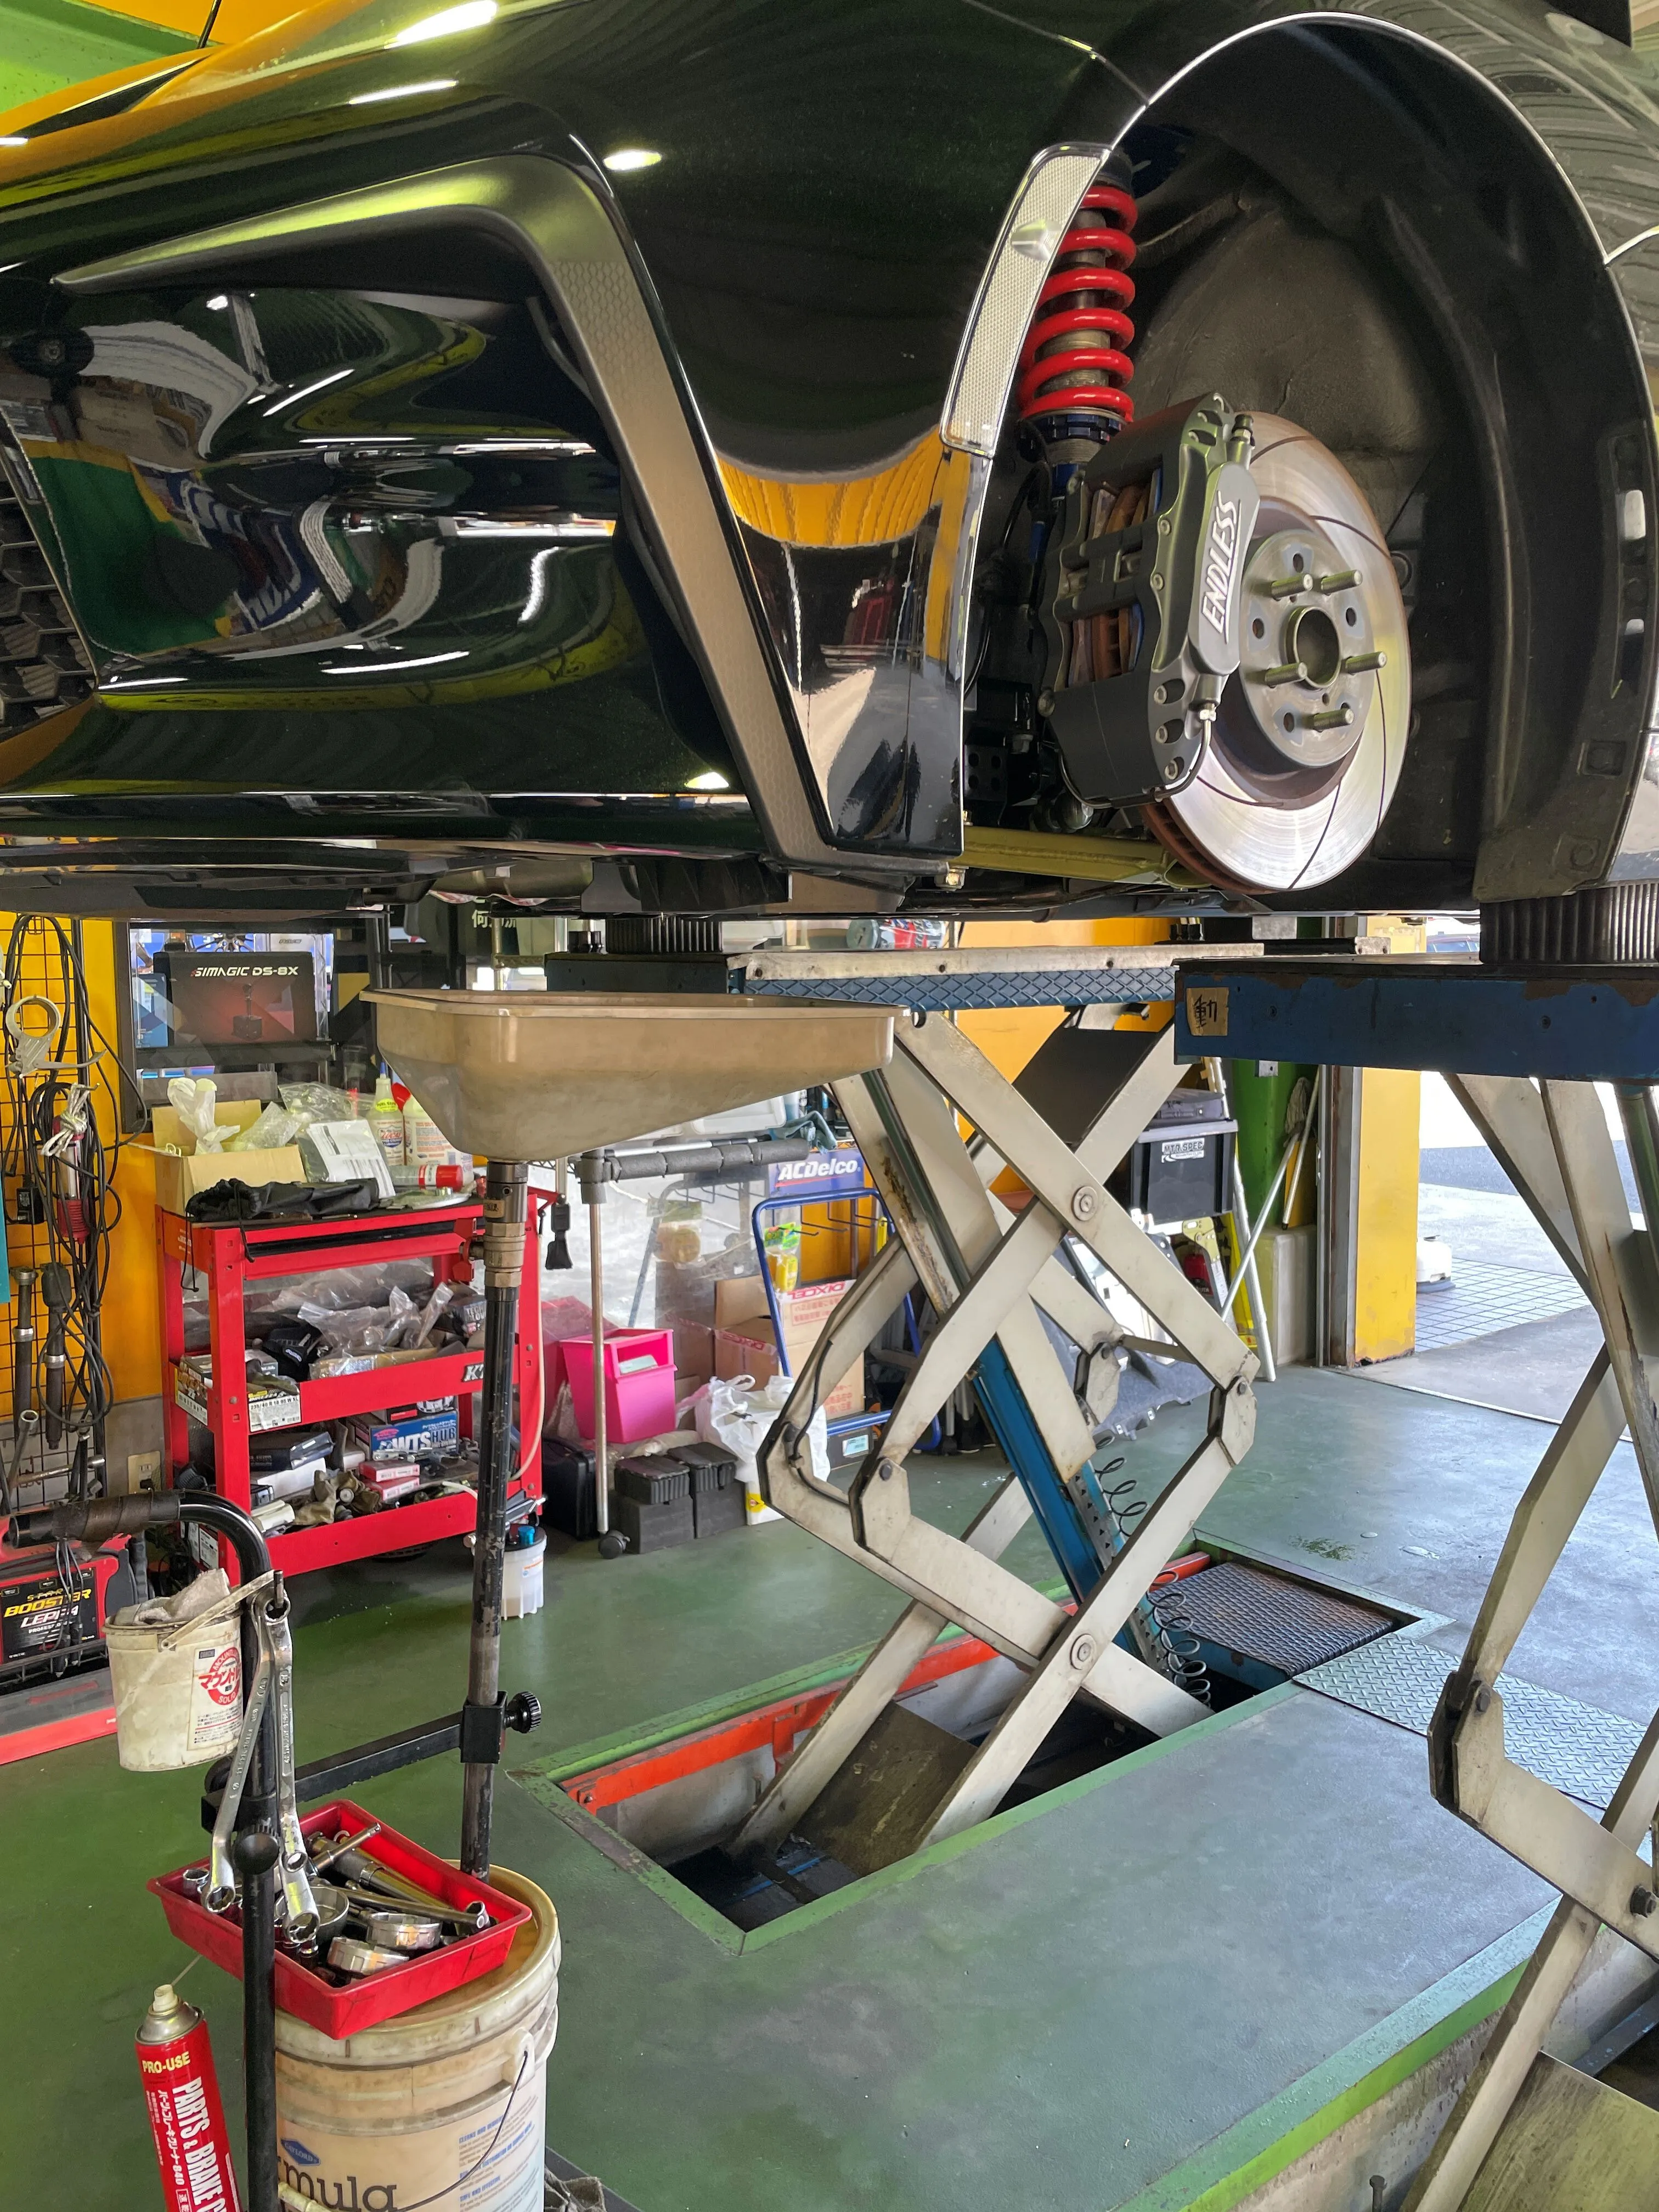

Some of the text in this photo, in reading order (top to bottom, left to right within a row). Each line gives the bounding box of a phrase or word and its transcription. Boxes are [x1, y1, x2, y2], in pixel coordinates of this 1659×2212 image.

[1202, 490, 1237, 633] ENDLESS
[194, 966, 298, 977] SIMAGIC DS-8X
[1183, 1142, 1203, 1152] SPEC
[778, 1158, 857, 1181] ACDelco
[787, 1281, 845, 1300] DIXCEL
[218, 1692, 236, 1703] SOLID
[142, 2051, 191, 2074] PRO-USE
[172, 2076, 211, 2139] PARTS
[183, 2139, 198, 2150] &
[185, 2141, 223, 2206] BRAKE
[277, 2155, 399, 2212] mula
